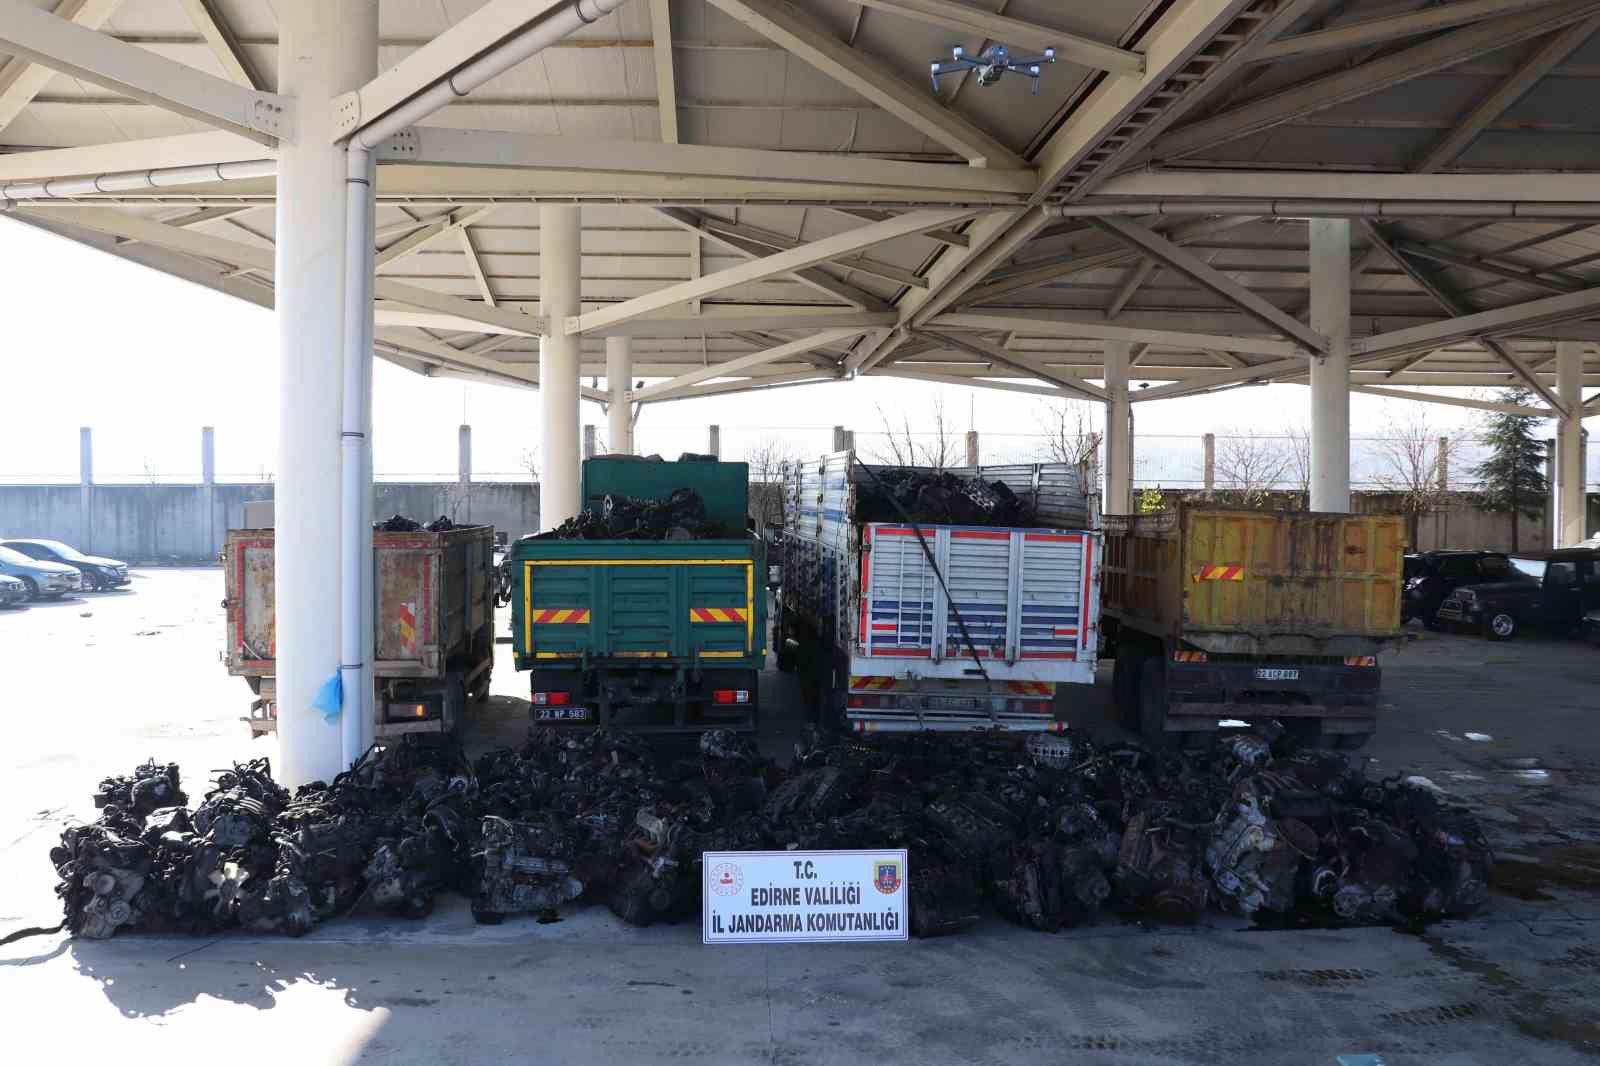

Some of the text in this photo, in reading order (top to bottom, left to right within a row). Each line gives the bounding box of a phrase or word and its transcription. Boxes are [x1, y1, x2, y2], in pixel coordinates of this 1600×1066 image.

[793, 860, 818, 880] T.C.
[751, 882, 801, 906] EDİRNE
[805, 881, 860, 905] VALİLİĞİ
[712, 907, 899, 934] İL JANDARMA KOMUTANLIĞI
